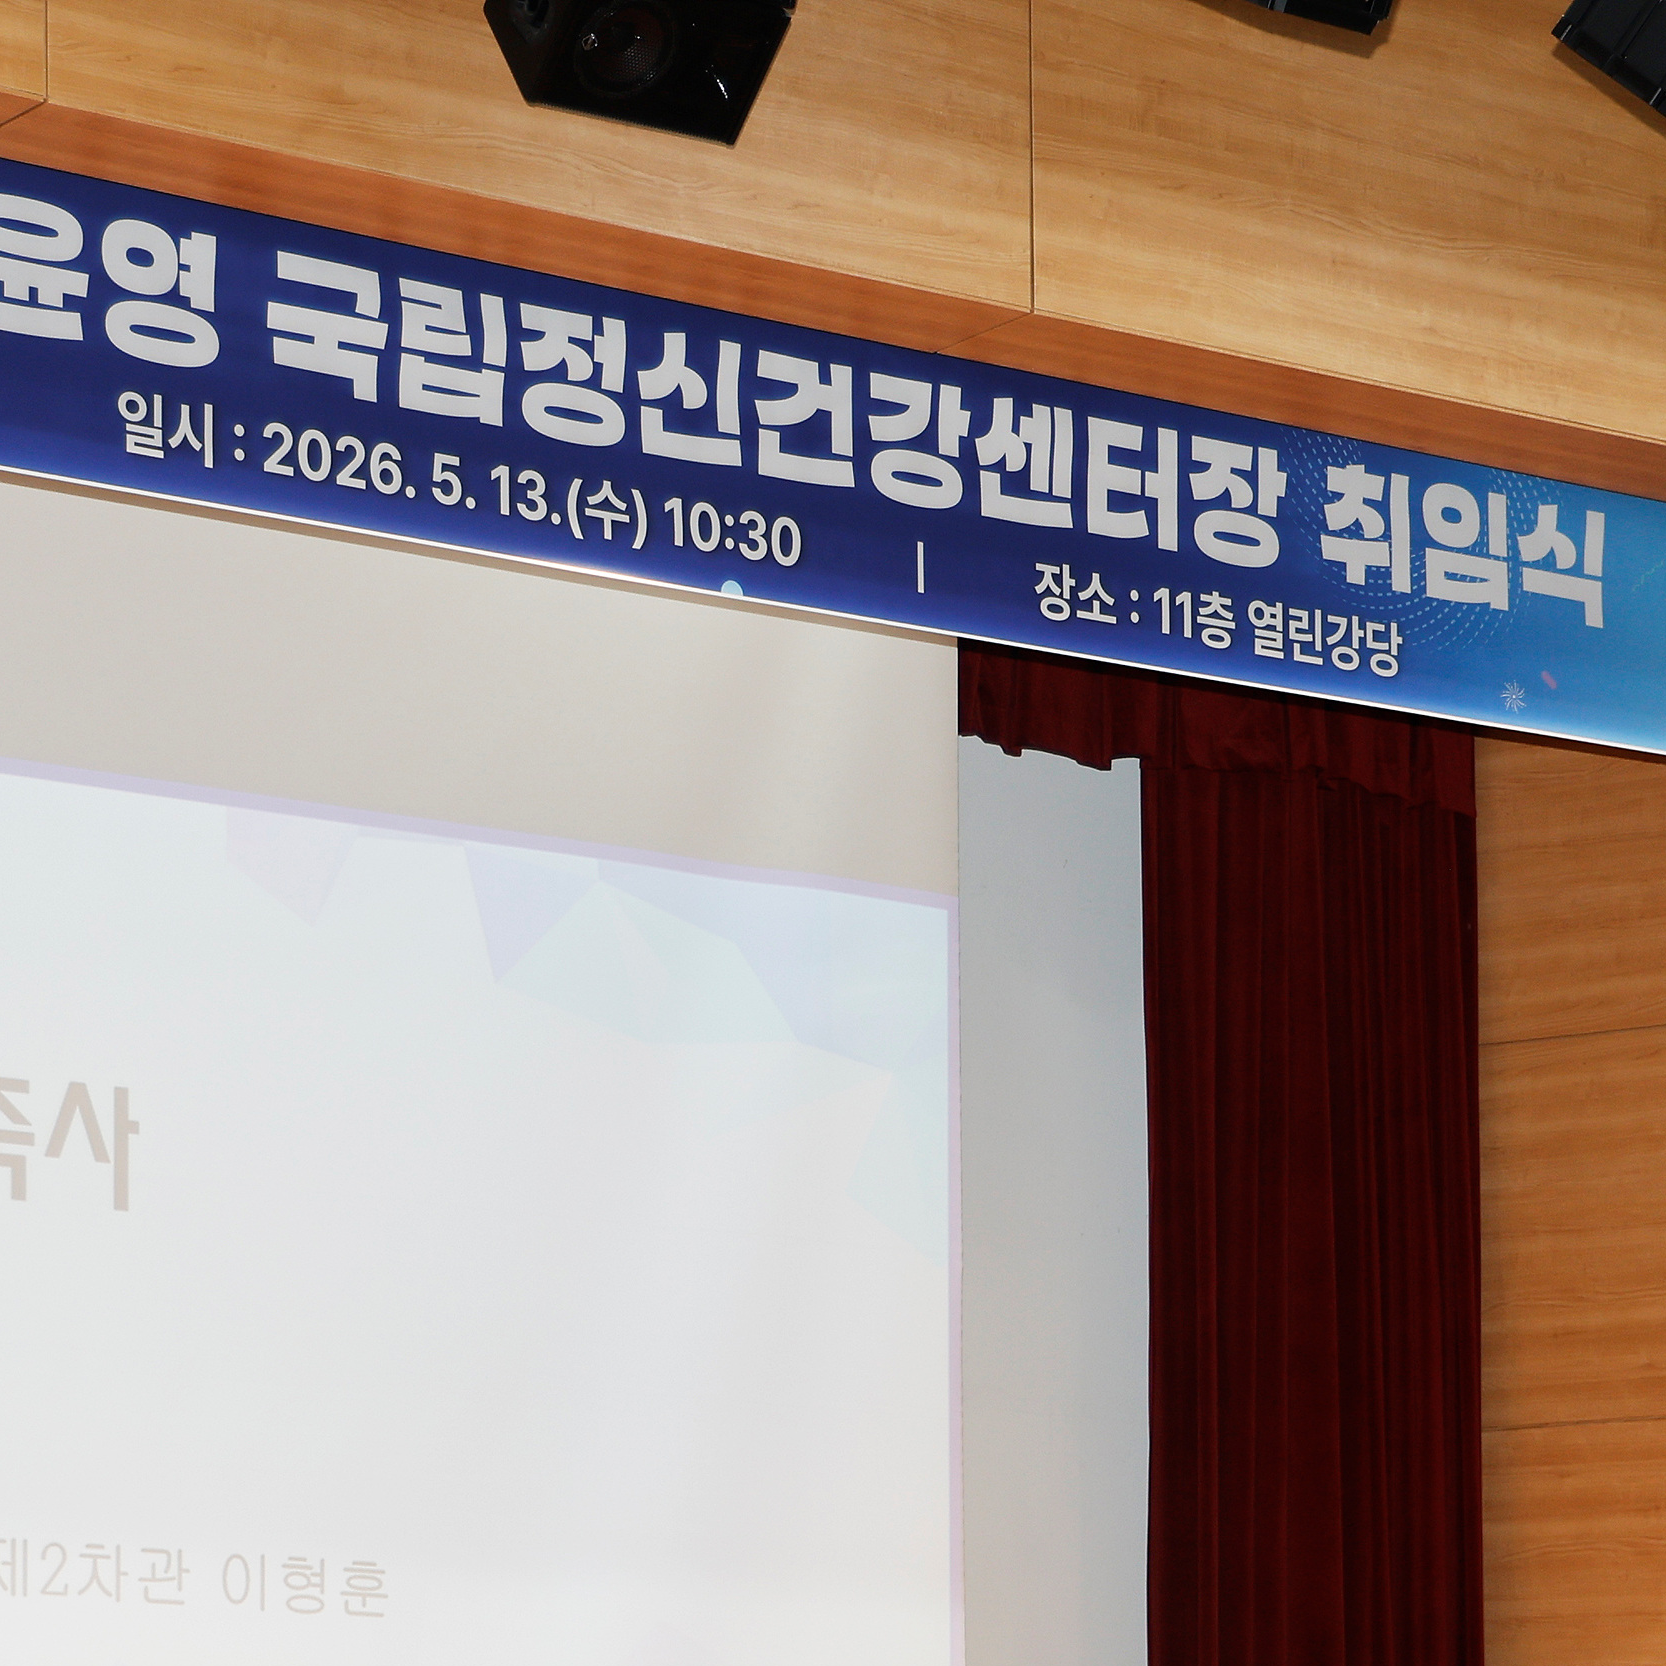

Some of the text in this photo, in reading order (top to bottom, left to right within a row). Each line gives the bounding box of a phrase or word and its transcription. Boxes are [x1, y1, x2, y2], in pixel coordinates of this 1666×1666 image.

[116, 390, 215, 470] 일시
[262, 422, 417, 499] 2026.
[431, 455, 477, 510] 5.
[490, 463, 647, 551] 13.(수)
[664, 496, 804, 568] 10:30
[267, 250, 1287, 569] 국립정신건강센터장
[1321, 462, 1606, 629] 취임식
[1033, 561, 1118, 625] 장소
[1151, 586, 1237, 652] 11층
[1247, 599, 1404, 679] 열린강당
[220, 1552, 391, 1619] 이형훈
